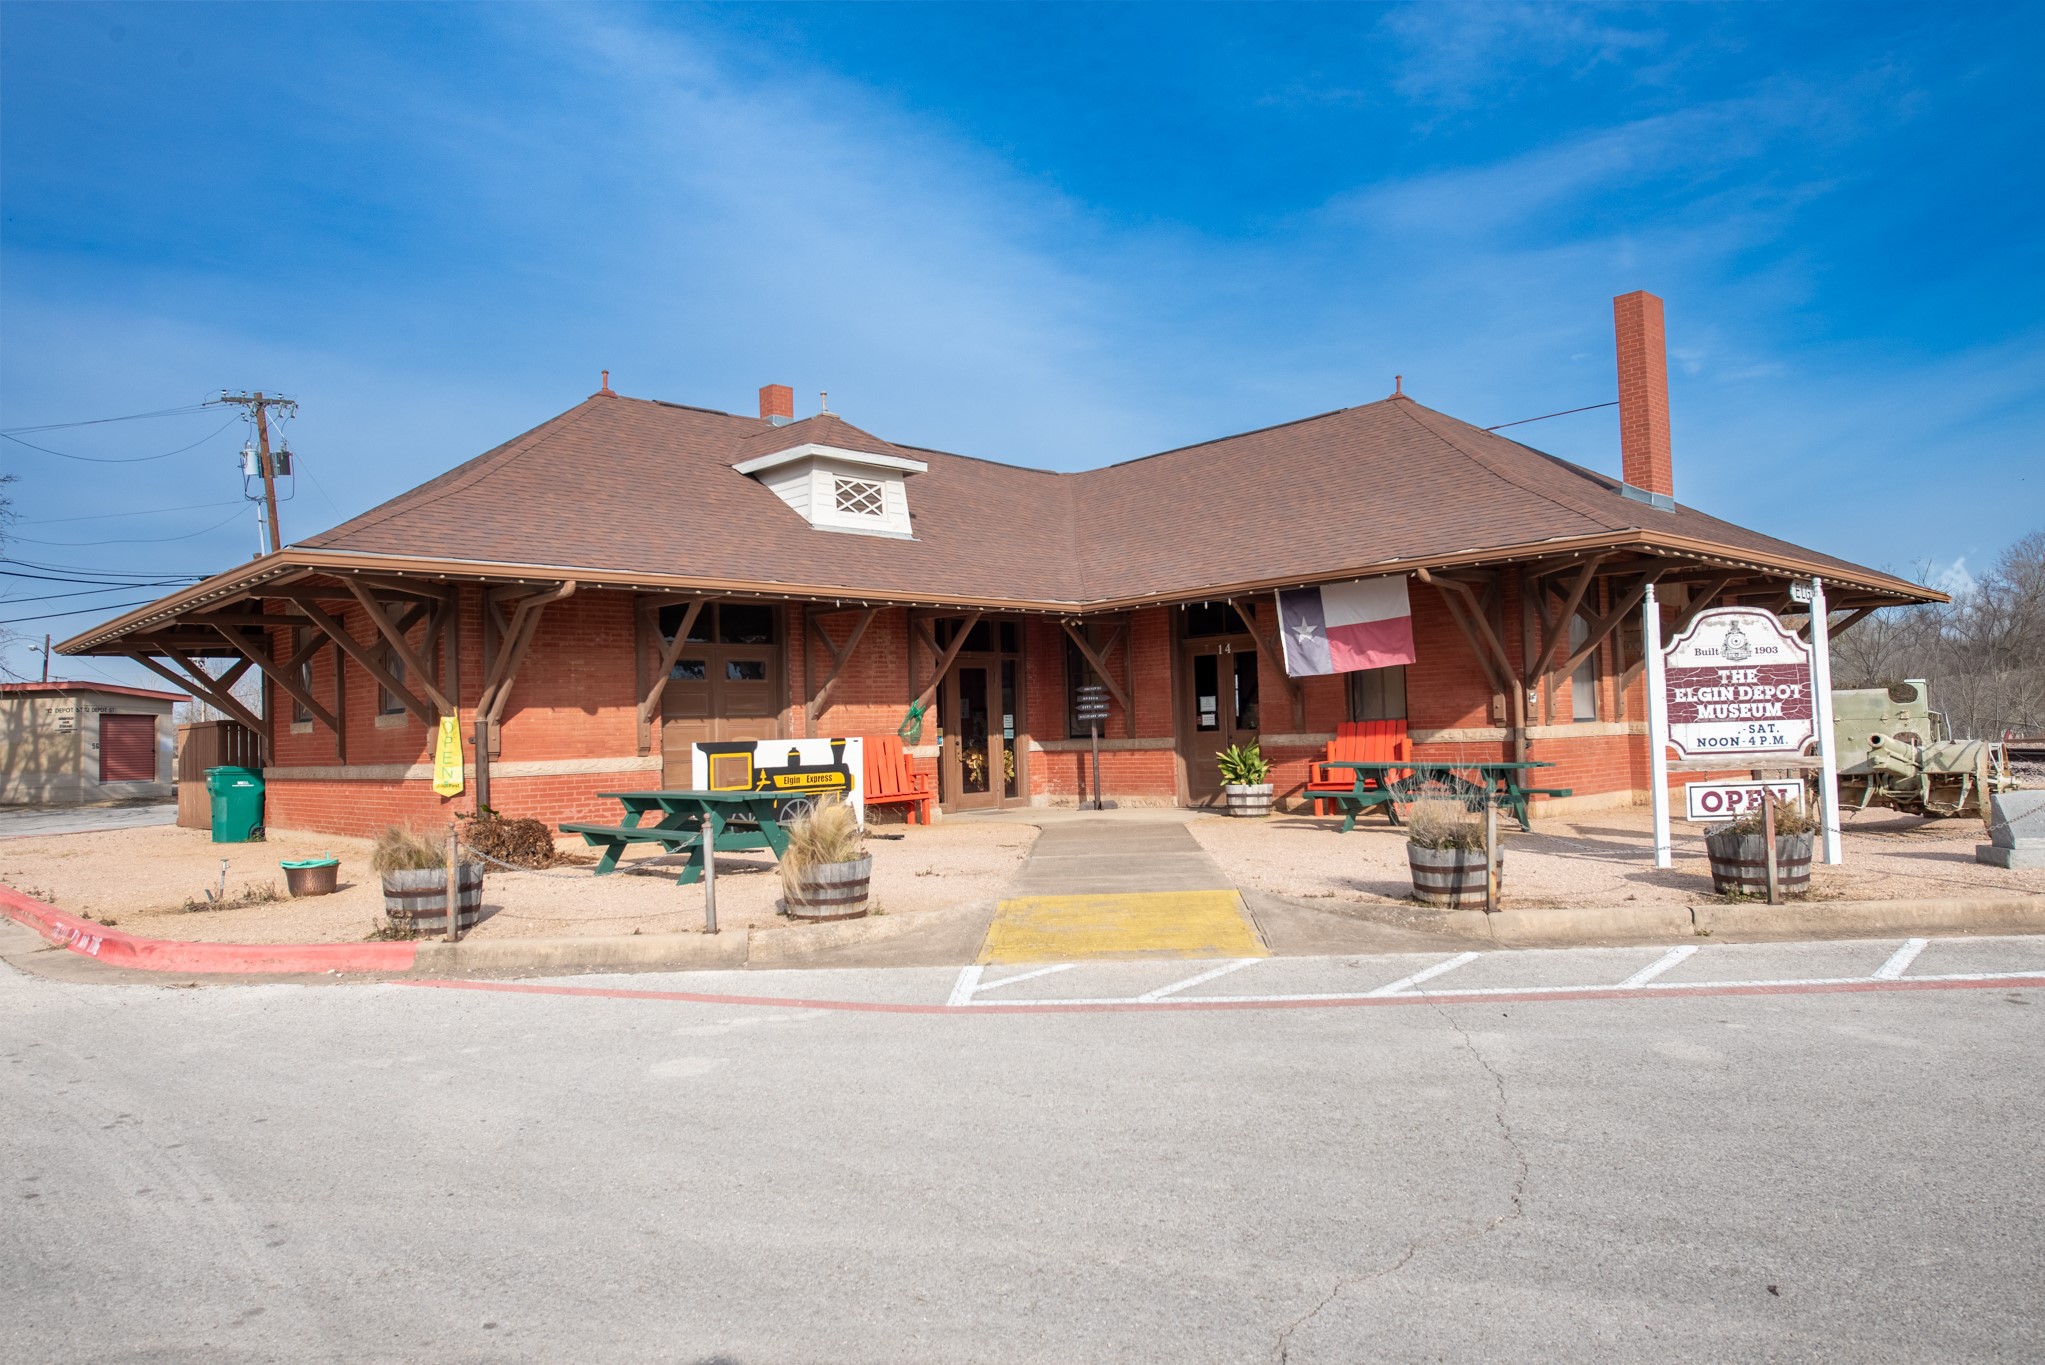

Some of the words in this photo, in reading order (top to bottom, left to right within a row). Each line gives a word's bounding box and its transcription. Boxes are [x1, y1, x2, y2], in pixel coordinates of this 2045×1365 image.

[1218, 643, 1231, 654] 14
[1694, 648, 1720, 656] Built
[1754, 646, 1779, 654] 1903
[1718, 669, 1758, 684] THE
[1674, 686, 1734, 702] ELGIN
[1738, 684, 1801, 700] DEPOT
[1697, 702, 1783, 719] MUSEUM
[1749, 723, 1780, 734] SAT.
[1697, 737, 1740, 747] NOON
[1749, 736, 1756, 746] 4
[442, 721, 454, 779] OPEN
[784, 776, 800, 785] Elgin
[806, 774, 832, 783] Express
